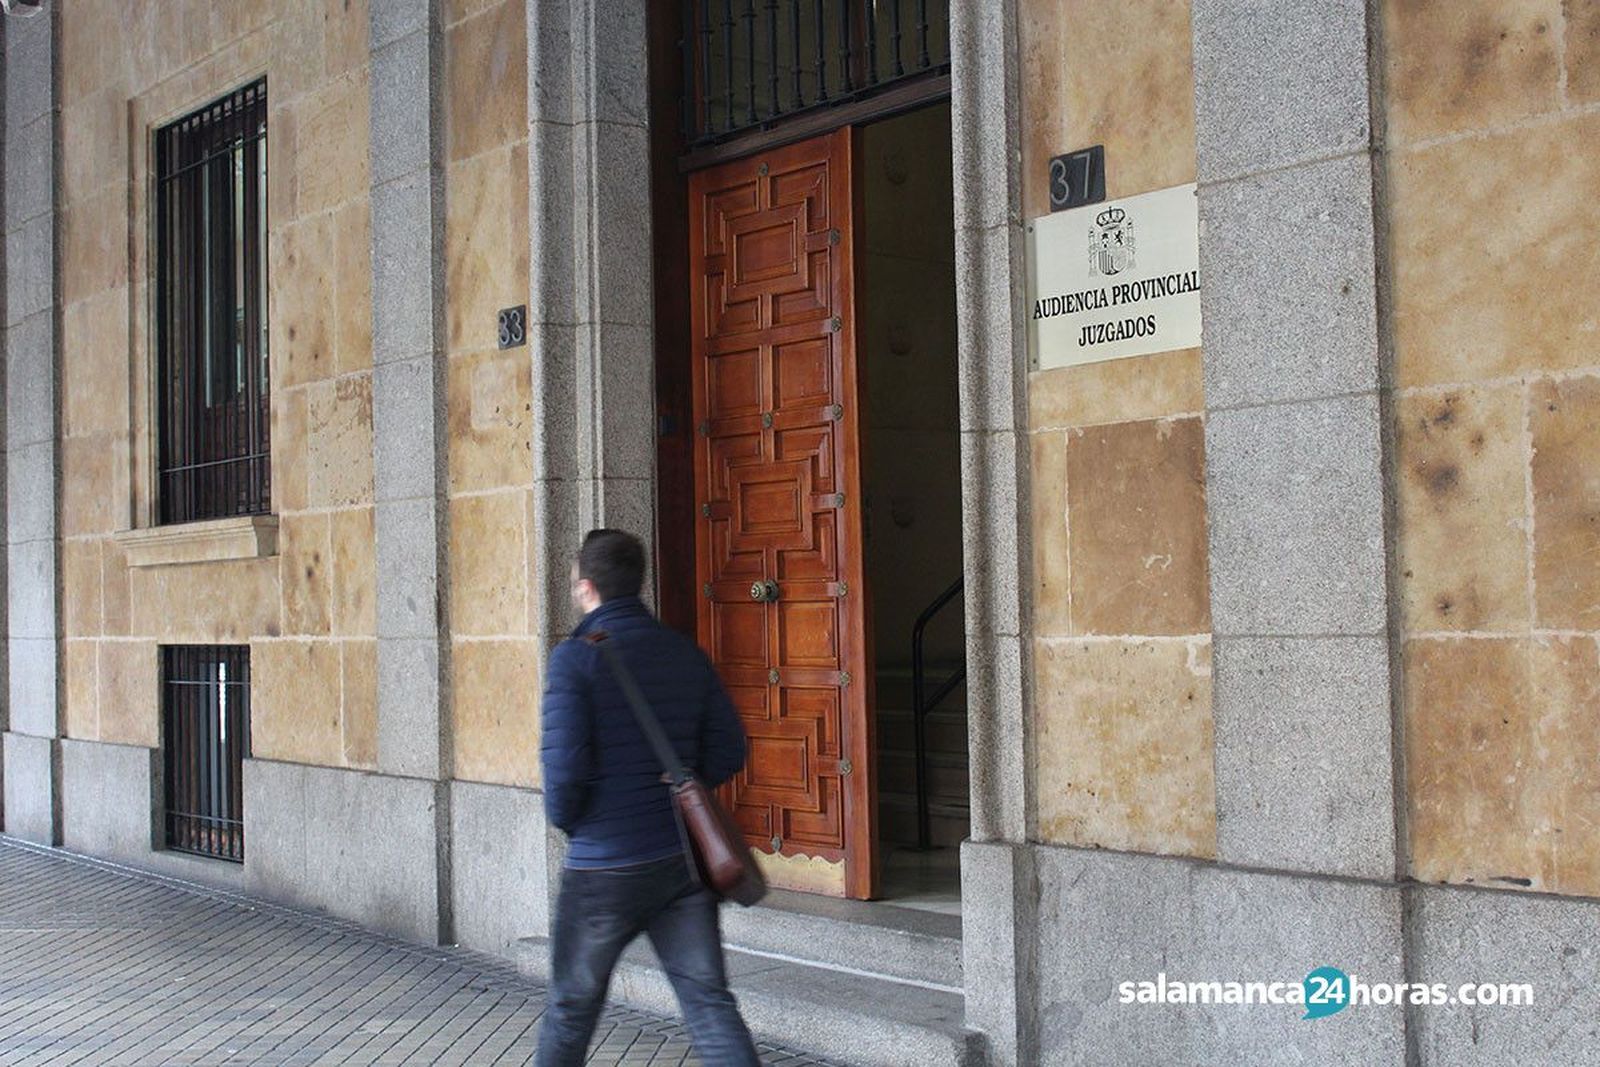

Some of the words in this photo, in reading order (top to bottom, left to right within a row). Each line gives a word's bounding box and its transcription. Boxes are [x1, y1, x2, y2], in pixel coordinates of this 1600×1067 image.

[1050, 152, 1091, 204] 37
[1033, 288, 1109, 320] AUDIENCIA
[1112, 271, 1200, 305] PROVINCIAL
[499, 310, 522, 345] 33
[1079, 315, 1156, 347] JUZGADOS
